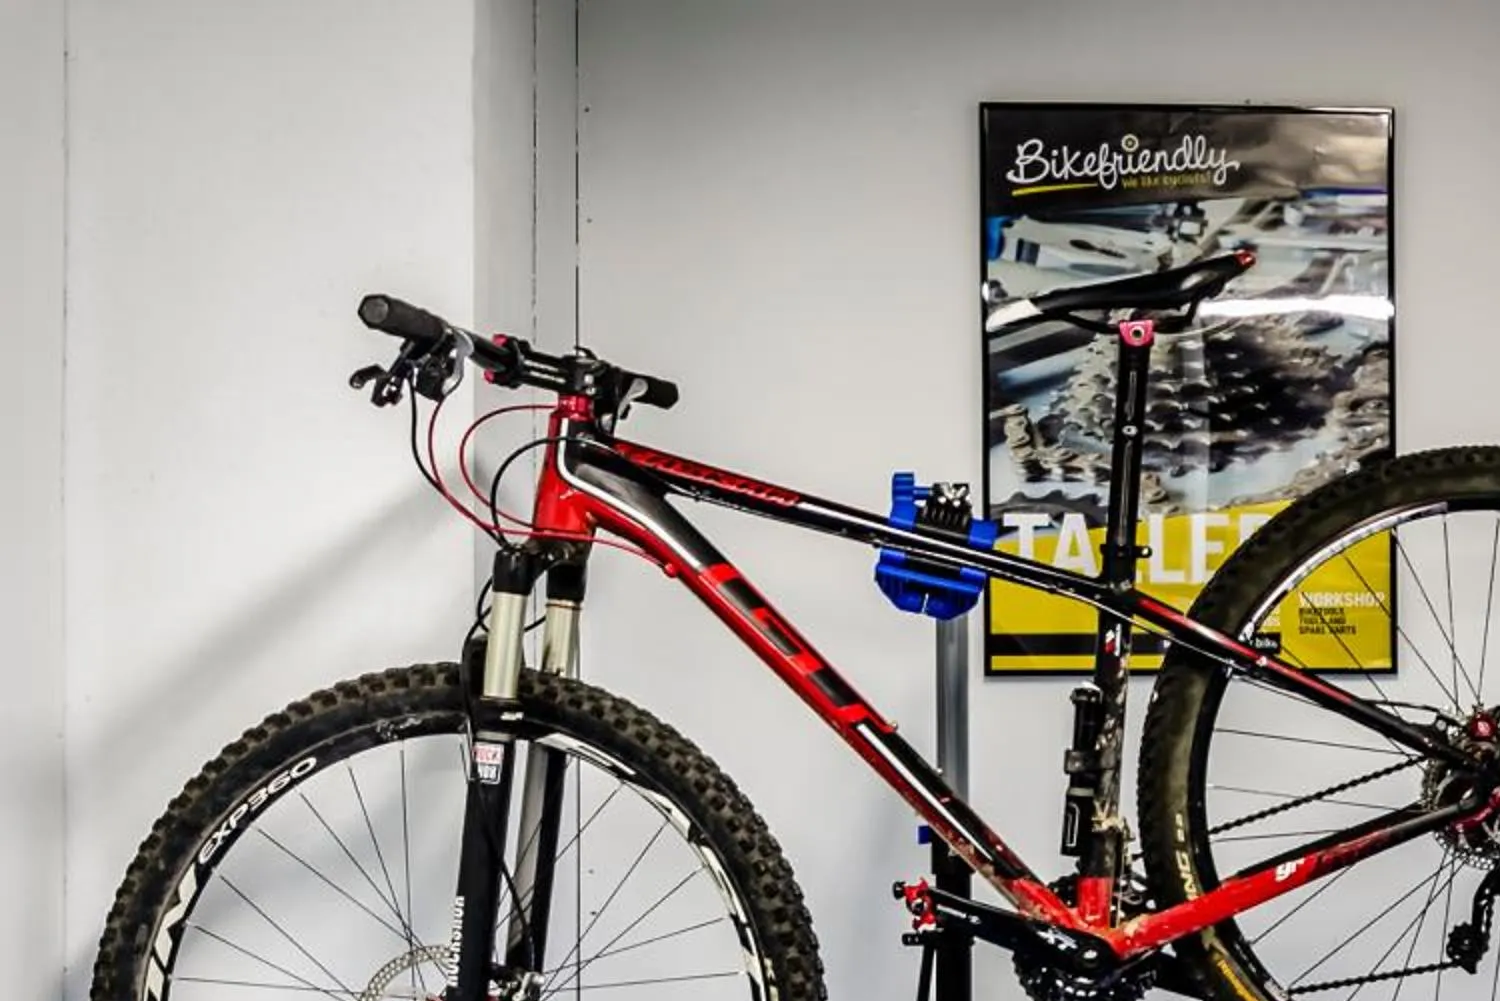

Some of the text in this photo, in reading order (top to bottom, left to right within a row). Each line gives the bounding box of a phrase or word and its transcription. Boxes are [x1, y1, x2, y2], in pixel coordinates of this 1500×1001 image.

[1006, 134, 1240, 190] Bikefriendly
[1003, 511, 1273, 585] TALE
[1299, 591, 1385, 607] WORKSHOP
[198, 757, 317, 864] EXP360
